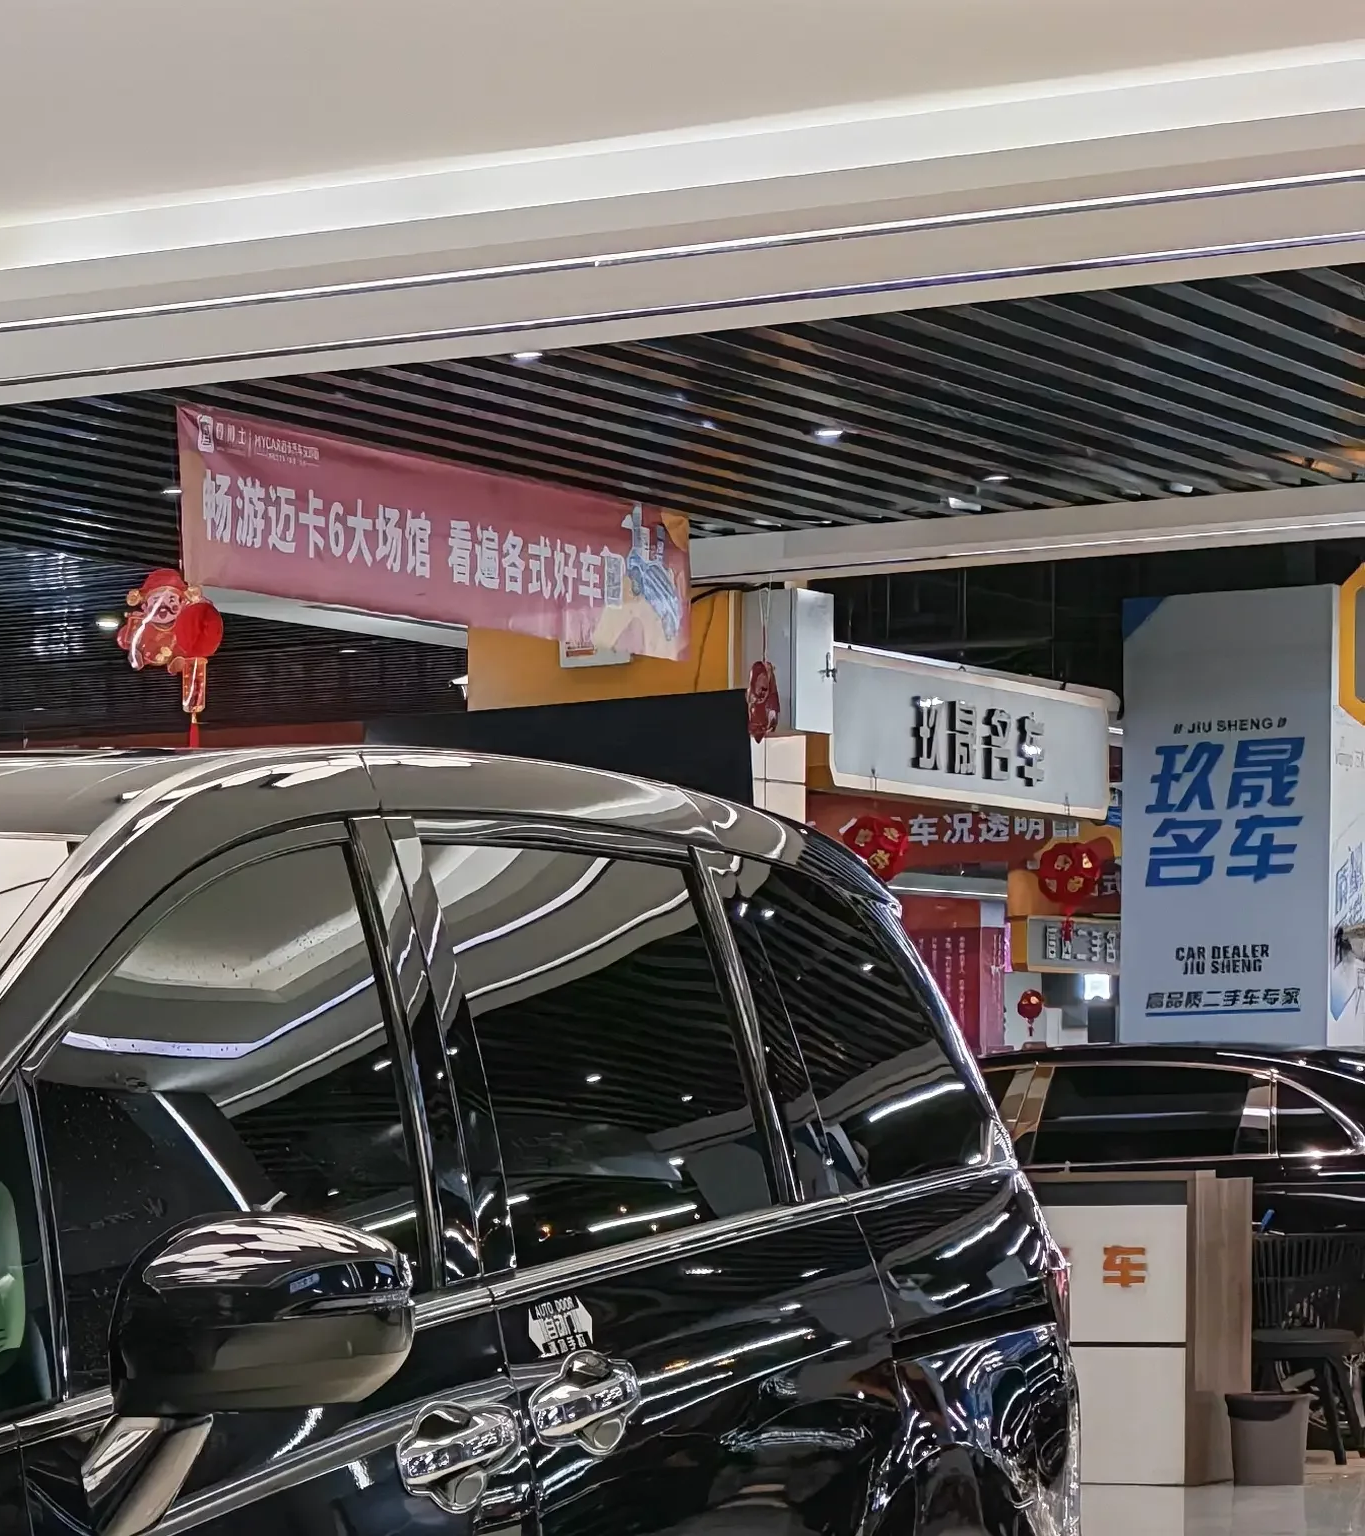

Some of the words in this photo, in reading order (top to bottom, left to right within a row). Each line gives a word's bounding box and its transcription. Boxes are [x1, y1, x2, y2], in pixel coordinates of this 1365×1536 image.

[201, 468, 432, 579] 畅游迈卡6大场馆
[447, 519, 604, 608] 看遍各式好车
[1187, 719, 1213, 734] JIU
[1216, 716, 1274, 733] SHENG
[1145, 736, 1306, 815] 玖晟
[1145, 815, 1304, 888] 名车
[1175, 946, 1207, 962] CAR
[1211, 943, 1270, 961] DEALER
[1210, 958, 1263, 974] SHENG
[1145, 987, 1301, 1010] 高品质二手车专家
[1102, 1246, 1147, 1288] 车
[534, 1301, 554, 1319] AUTO
[554, 1296, 575, 1314] DOOR
